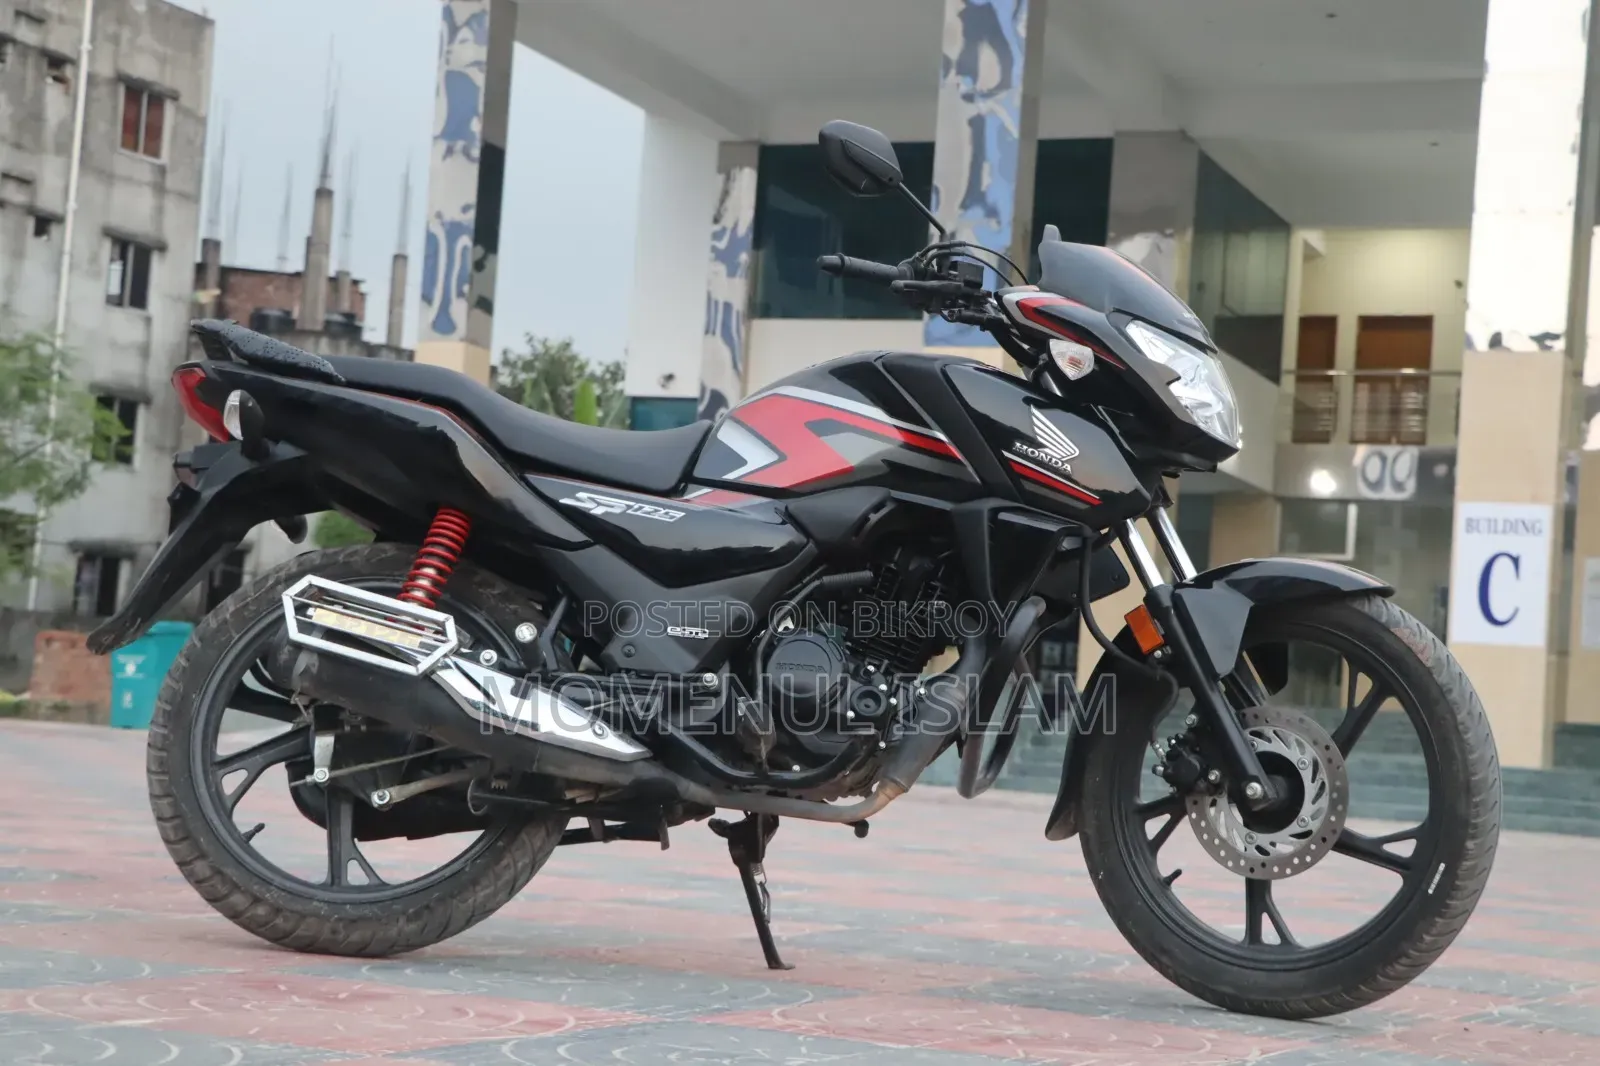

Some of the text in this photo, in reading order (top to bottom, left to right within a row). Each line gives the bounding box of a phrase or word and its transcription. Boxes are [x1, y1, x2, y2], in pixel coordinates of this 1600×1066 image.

[1013, 441, 1072, 474] HONDA
[1464, 517, 1544, 536] BUILDING
[1478, 551, 1520, 628] C
